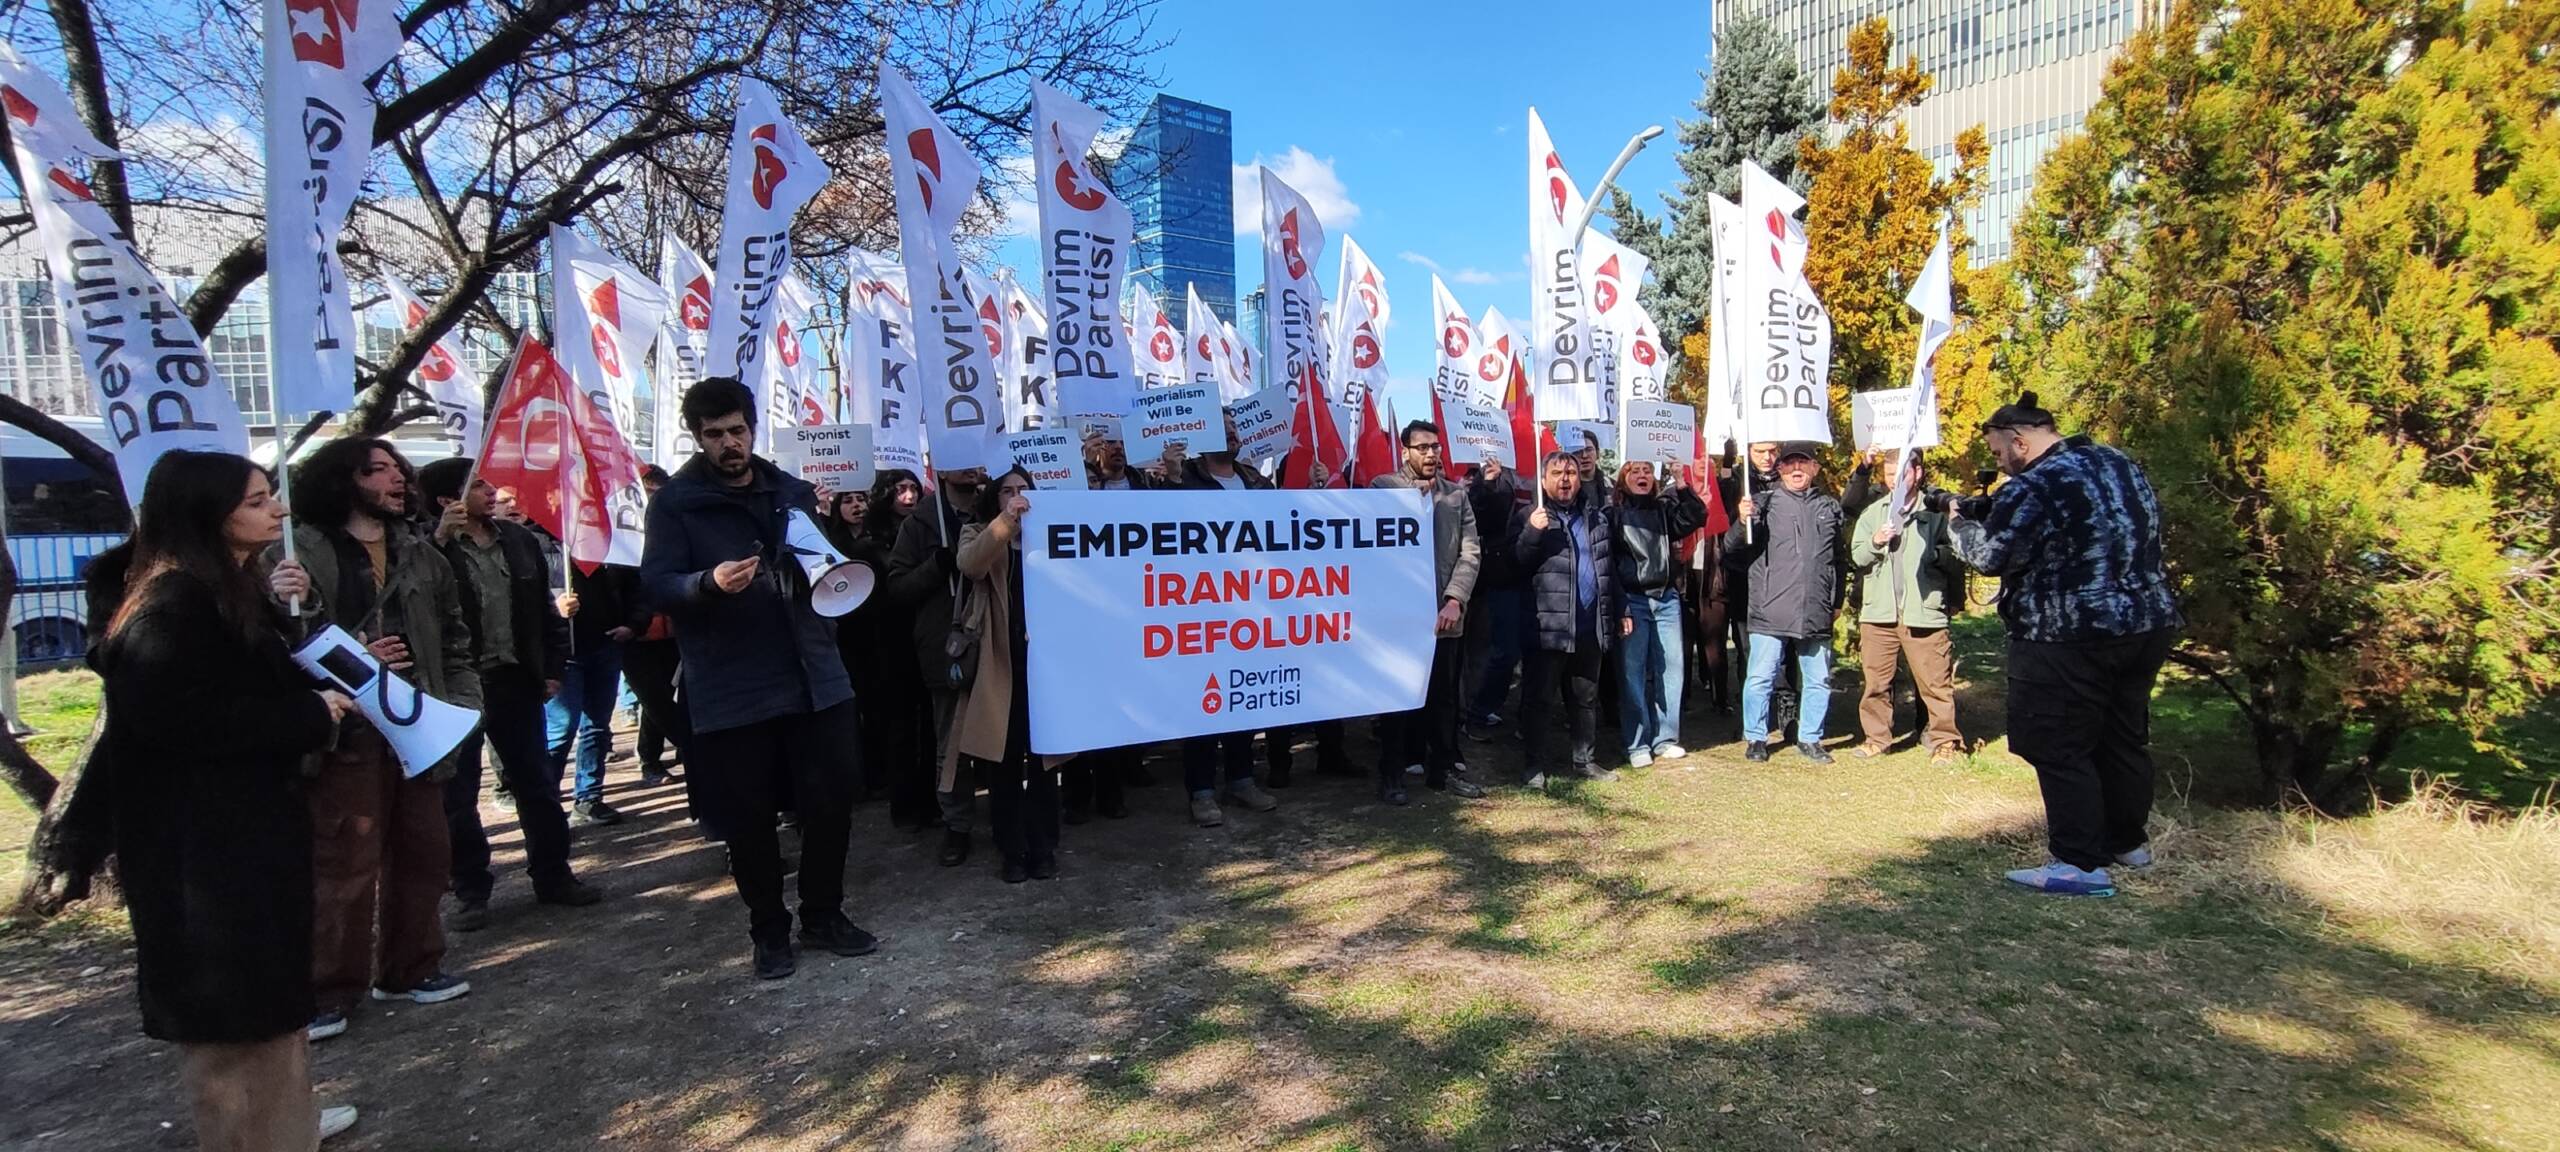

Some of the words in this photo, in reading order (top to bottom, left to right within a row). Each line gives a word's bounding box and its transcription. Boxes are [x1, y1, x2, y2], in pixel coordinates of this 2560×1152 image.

[1048, 229, 1083, 378] Devrim
[1085, 231, 1119, 379] Partisi
[1547, 248, 1579, 386] Devrim
[67, 238, 141, 448] Devrim
[1760, 288, 1790, 410] Devrim
[1132, 388, 1206, 409] Imperialism
[1147, 406, 1172, 420] Will
[1175, 405, 1193, 416] Be
[1230, 399, 1260, 418] Down
[1255, 409, 1273, 424] US
[1465, 407, 1492, 418] Down
[1656, 410, 1672, 418] ABD
[797, 429, 851, 442] Siyonist
[1142, 419, 1206, 438] Defeated!
[1462, 421, 1485, 433] With
[1486, 423, 1499, 434] US
[810, 445, 841, 457] İsrail
[1009, 434, 1067, 451] perialism
[1456, 434, 1508, 449] Imperialism!
[802, 461, 859, 473] enilecek!
[1014, 452, 1039, 466] Will
[1041, 452, 1058, 463] Be
[1047, 509, 1421, 559] EMPERYALİSTLER
[1143, 563, 1351, 607] İRAN'DAN
[1143, 611, 1352, 658] DEFOLUN!
[1229, 665, 1301, 689] Devrim
[1229, 685, 1301, 713] Partisi
